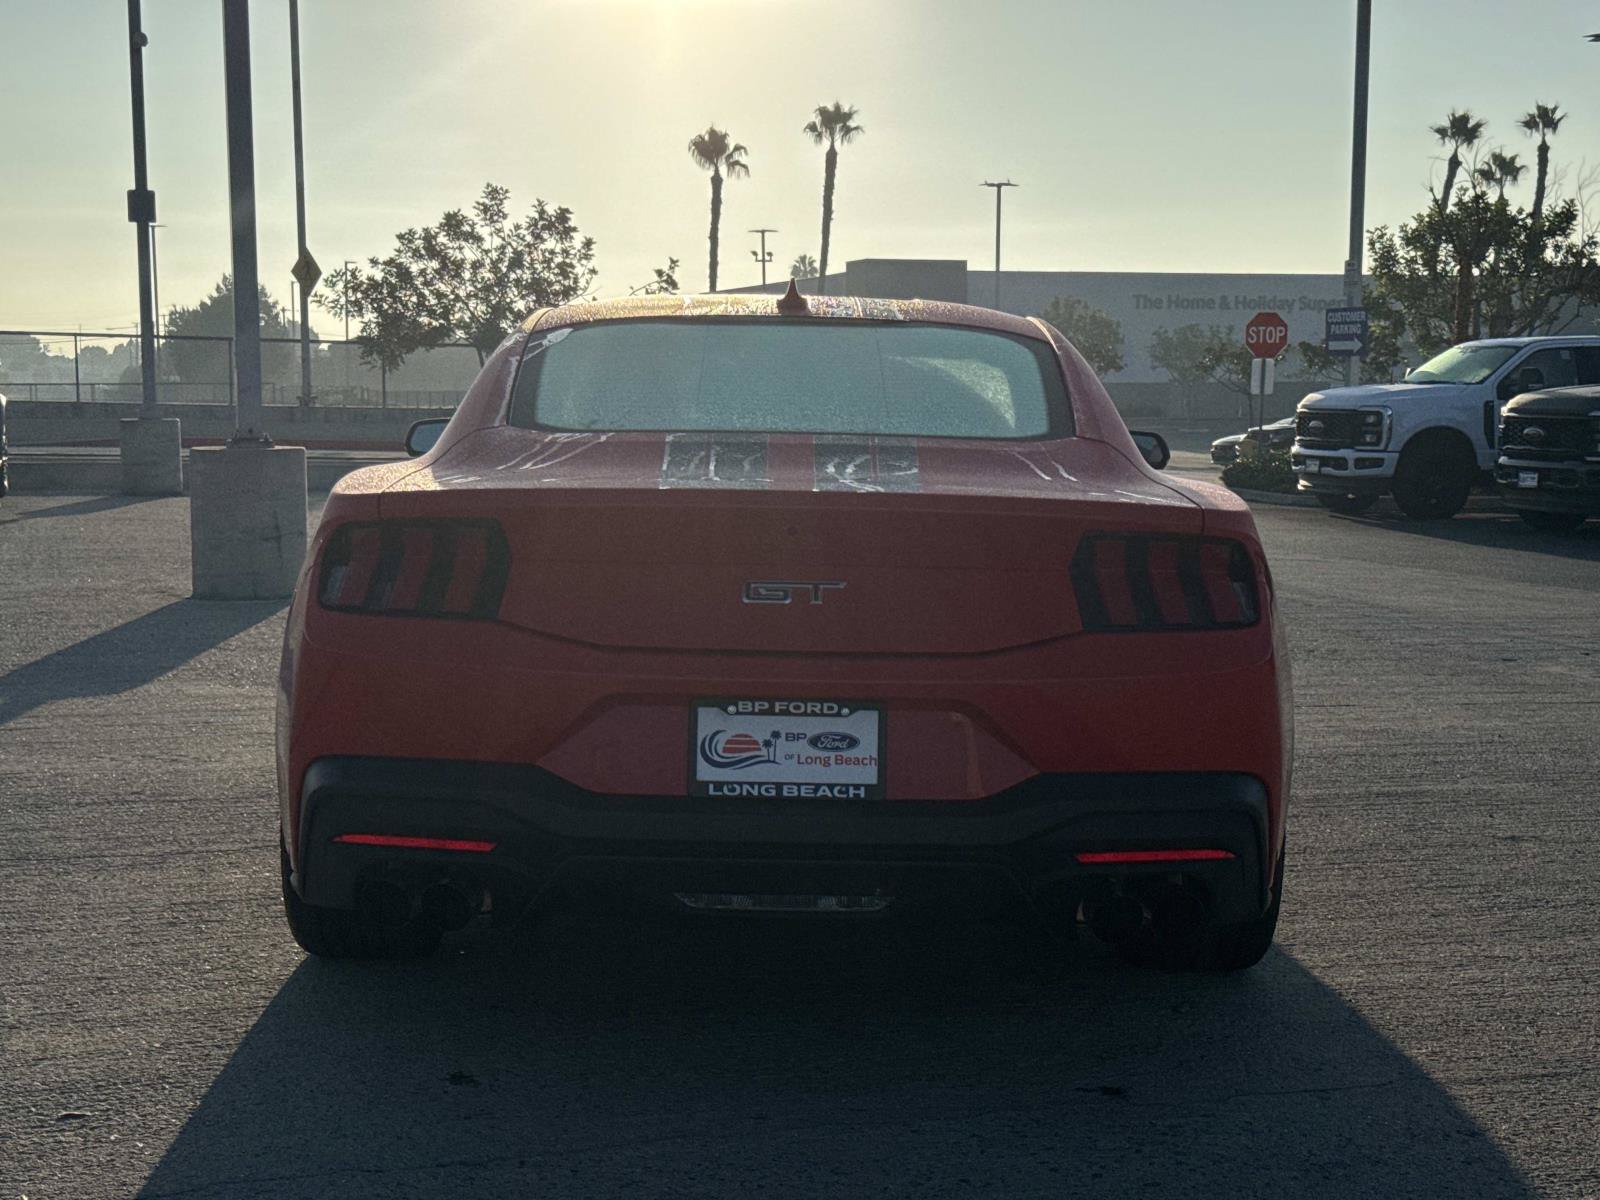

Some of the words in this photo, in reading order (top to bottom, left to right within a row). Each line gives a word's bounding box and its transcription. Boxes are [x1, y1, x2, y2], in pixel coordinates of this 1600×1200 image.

[1132, 294, 1163, 310] The
[1167, 294, 1216, 310] Home
[1218, 295, 1232, 310] &
[1234, 295, 1295, 314] Holiday
[1327, 311, 1367, 323] CUSTOMER
[1247, 326, 1286, 344] STOP
[1330, 323, 1362, 335] PARKING
[742, 581, 848, 604] GT
[738, 701, 770, 713] BP
[774, 702, 839, 715] FORD
[784, 732, 807, 742] BP
[796, 754, 832, 768] Long
[834, 755, 878, 767] Beach
[708, 783, 777, 796] LONG
[782, 784, 866, 798] BEACH
